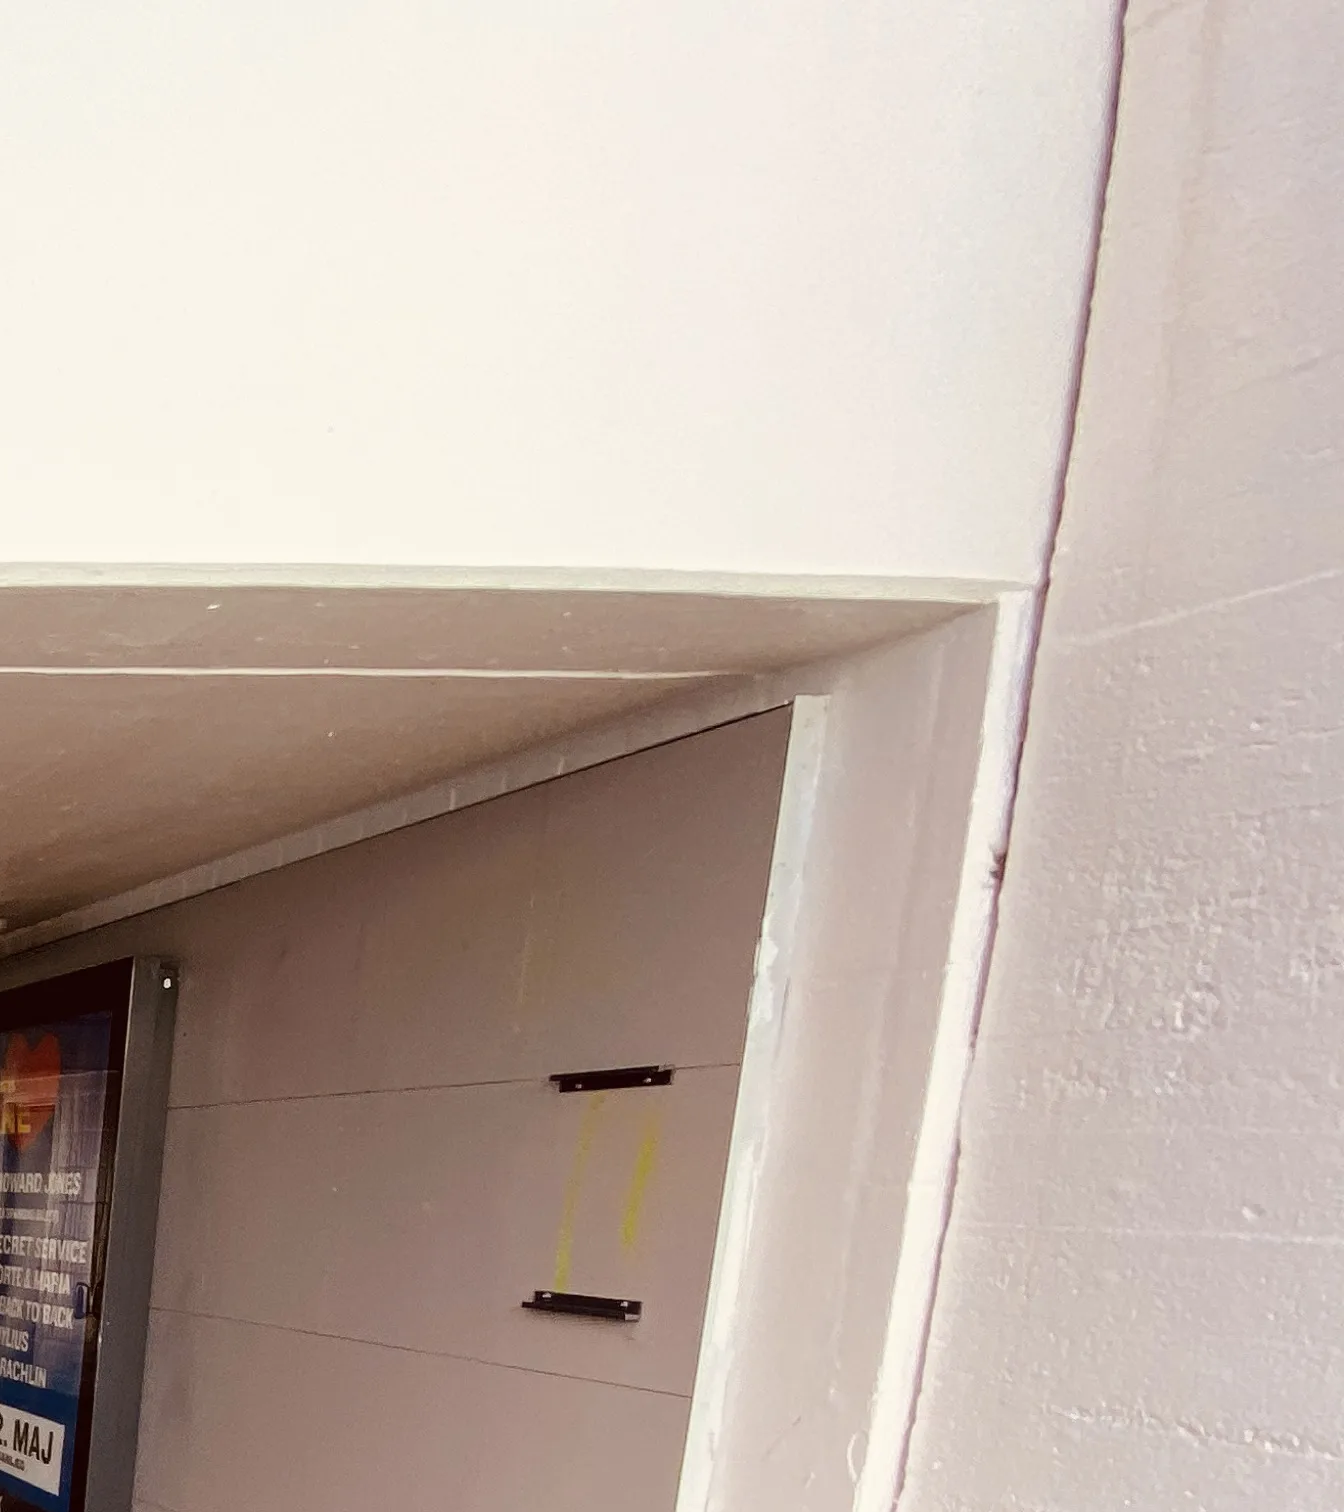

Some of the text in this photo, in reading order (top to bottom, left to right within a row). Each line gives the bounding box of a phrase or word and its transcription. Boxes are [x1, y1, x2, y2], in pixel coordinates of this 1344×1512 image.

[35, 1236, 90, 1263] SERVICE
[0, 1295, 24, 1320] BACK
[26, 1301, 40, 1322] TO
[42, 1302, 75, 1329] BACK
[13, 1418, 54, 1465] MAJ
